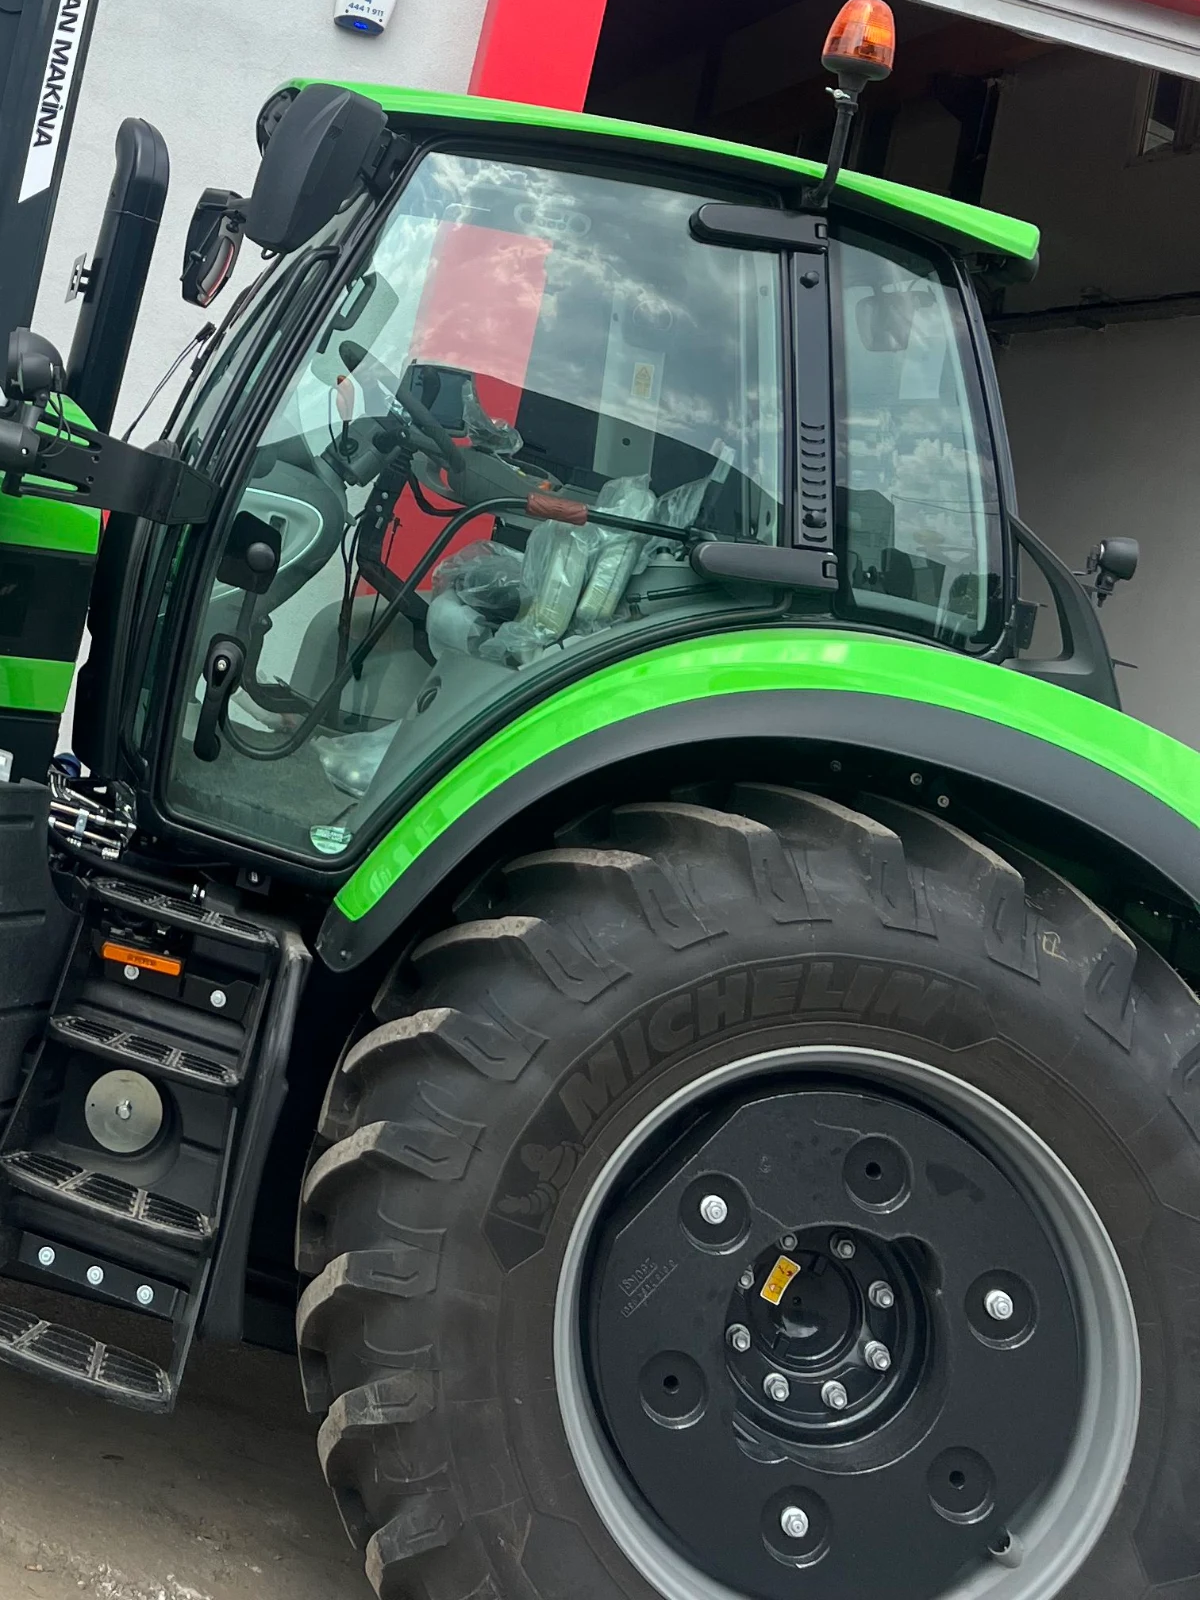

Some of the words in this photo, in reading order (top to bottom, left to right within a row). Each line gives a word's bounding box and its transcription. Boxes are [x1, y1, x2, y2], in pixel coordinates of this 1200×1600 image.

[348, 2, 365, 12] 444
[372, 8, 385, 17] 911
[33, 39, 73, 147] MAKİNA
[558, 961, 954, 1138] MICHELIN
